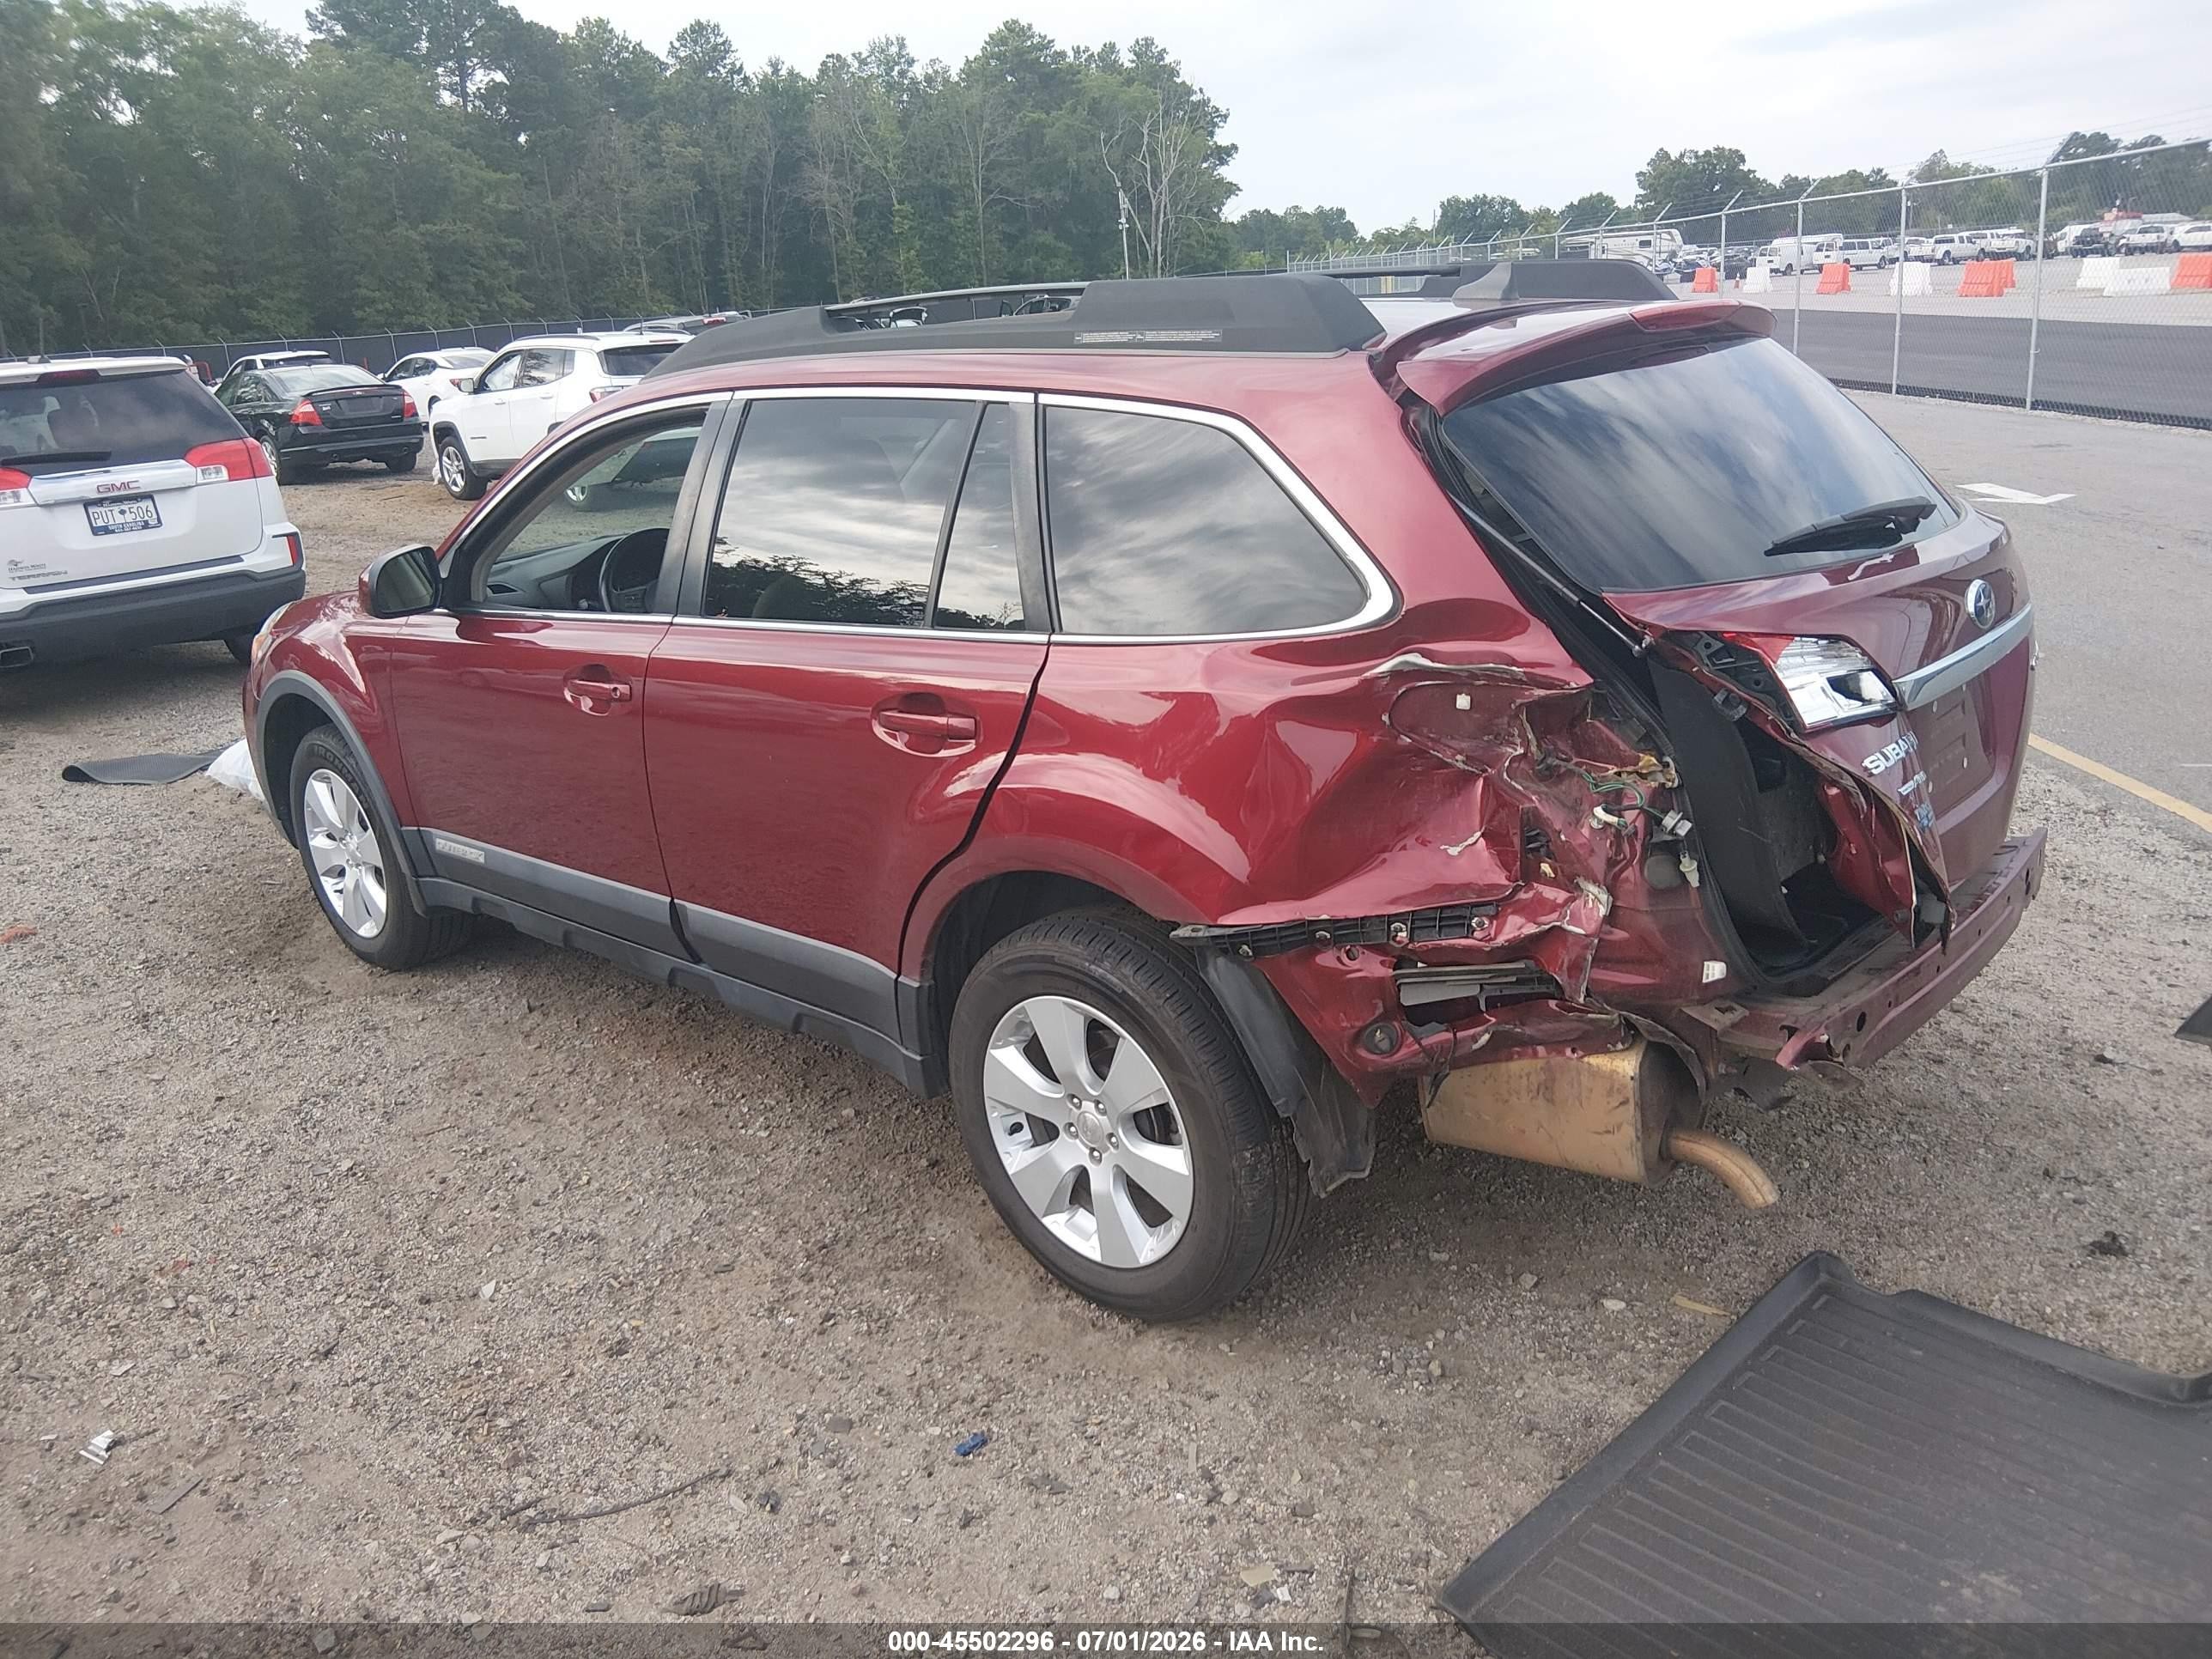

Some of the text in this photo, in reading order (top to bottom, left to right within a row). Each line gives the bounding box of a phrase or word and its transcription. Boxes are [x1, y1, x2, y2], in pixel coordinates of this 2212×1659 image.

[96, 480, 141, 494] GMC
[92, 508, 115, 526] PUT
[129, 504, 154, 520] 506
